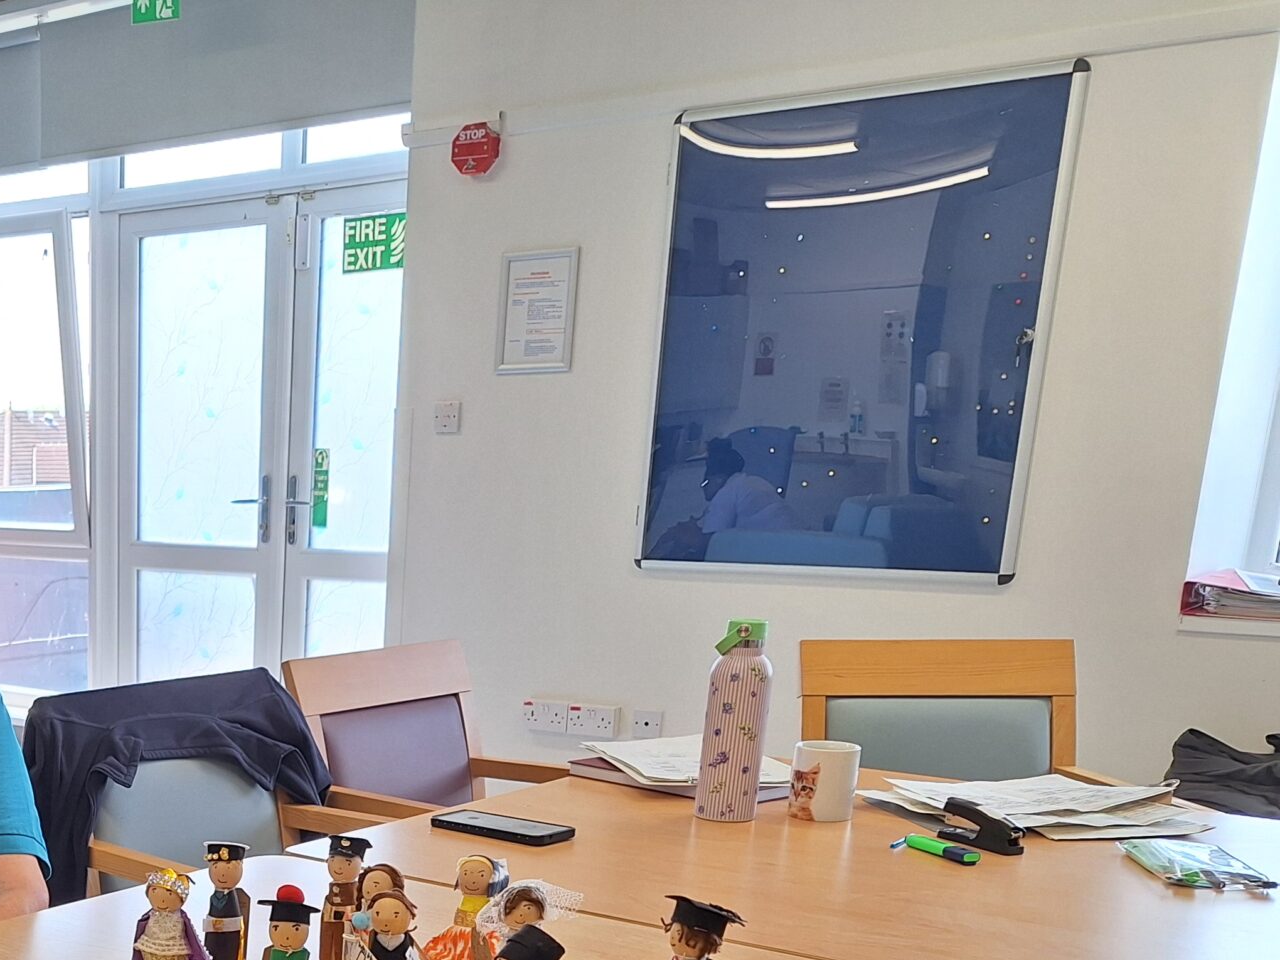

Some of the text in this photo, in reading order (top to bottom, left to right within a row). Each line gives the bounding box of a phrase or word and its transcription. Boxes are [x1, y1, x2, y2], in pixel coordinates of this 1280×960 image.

[459, 129, 486, 141] STOP
[345, 218, 387, 243] FIRE
[344, 246, 385, 270] EXIT
